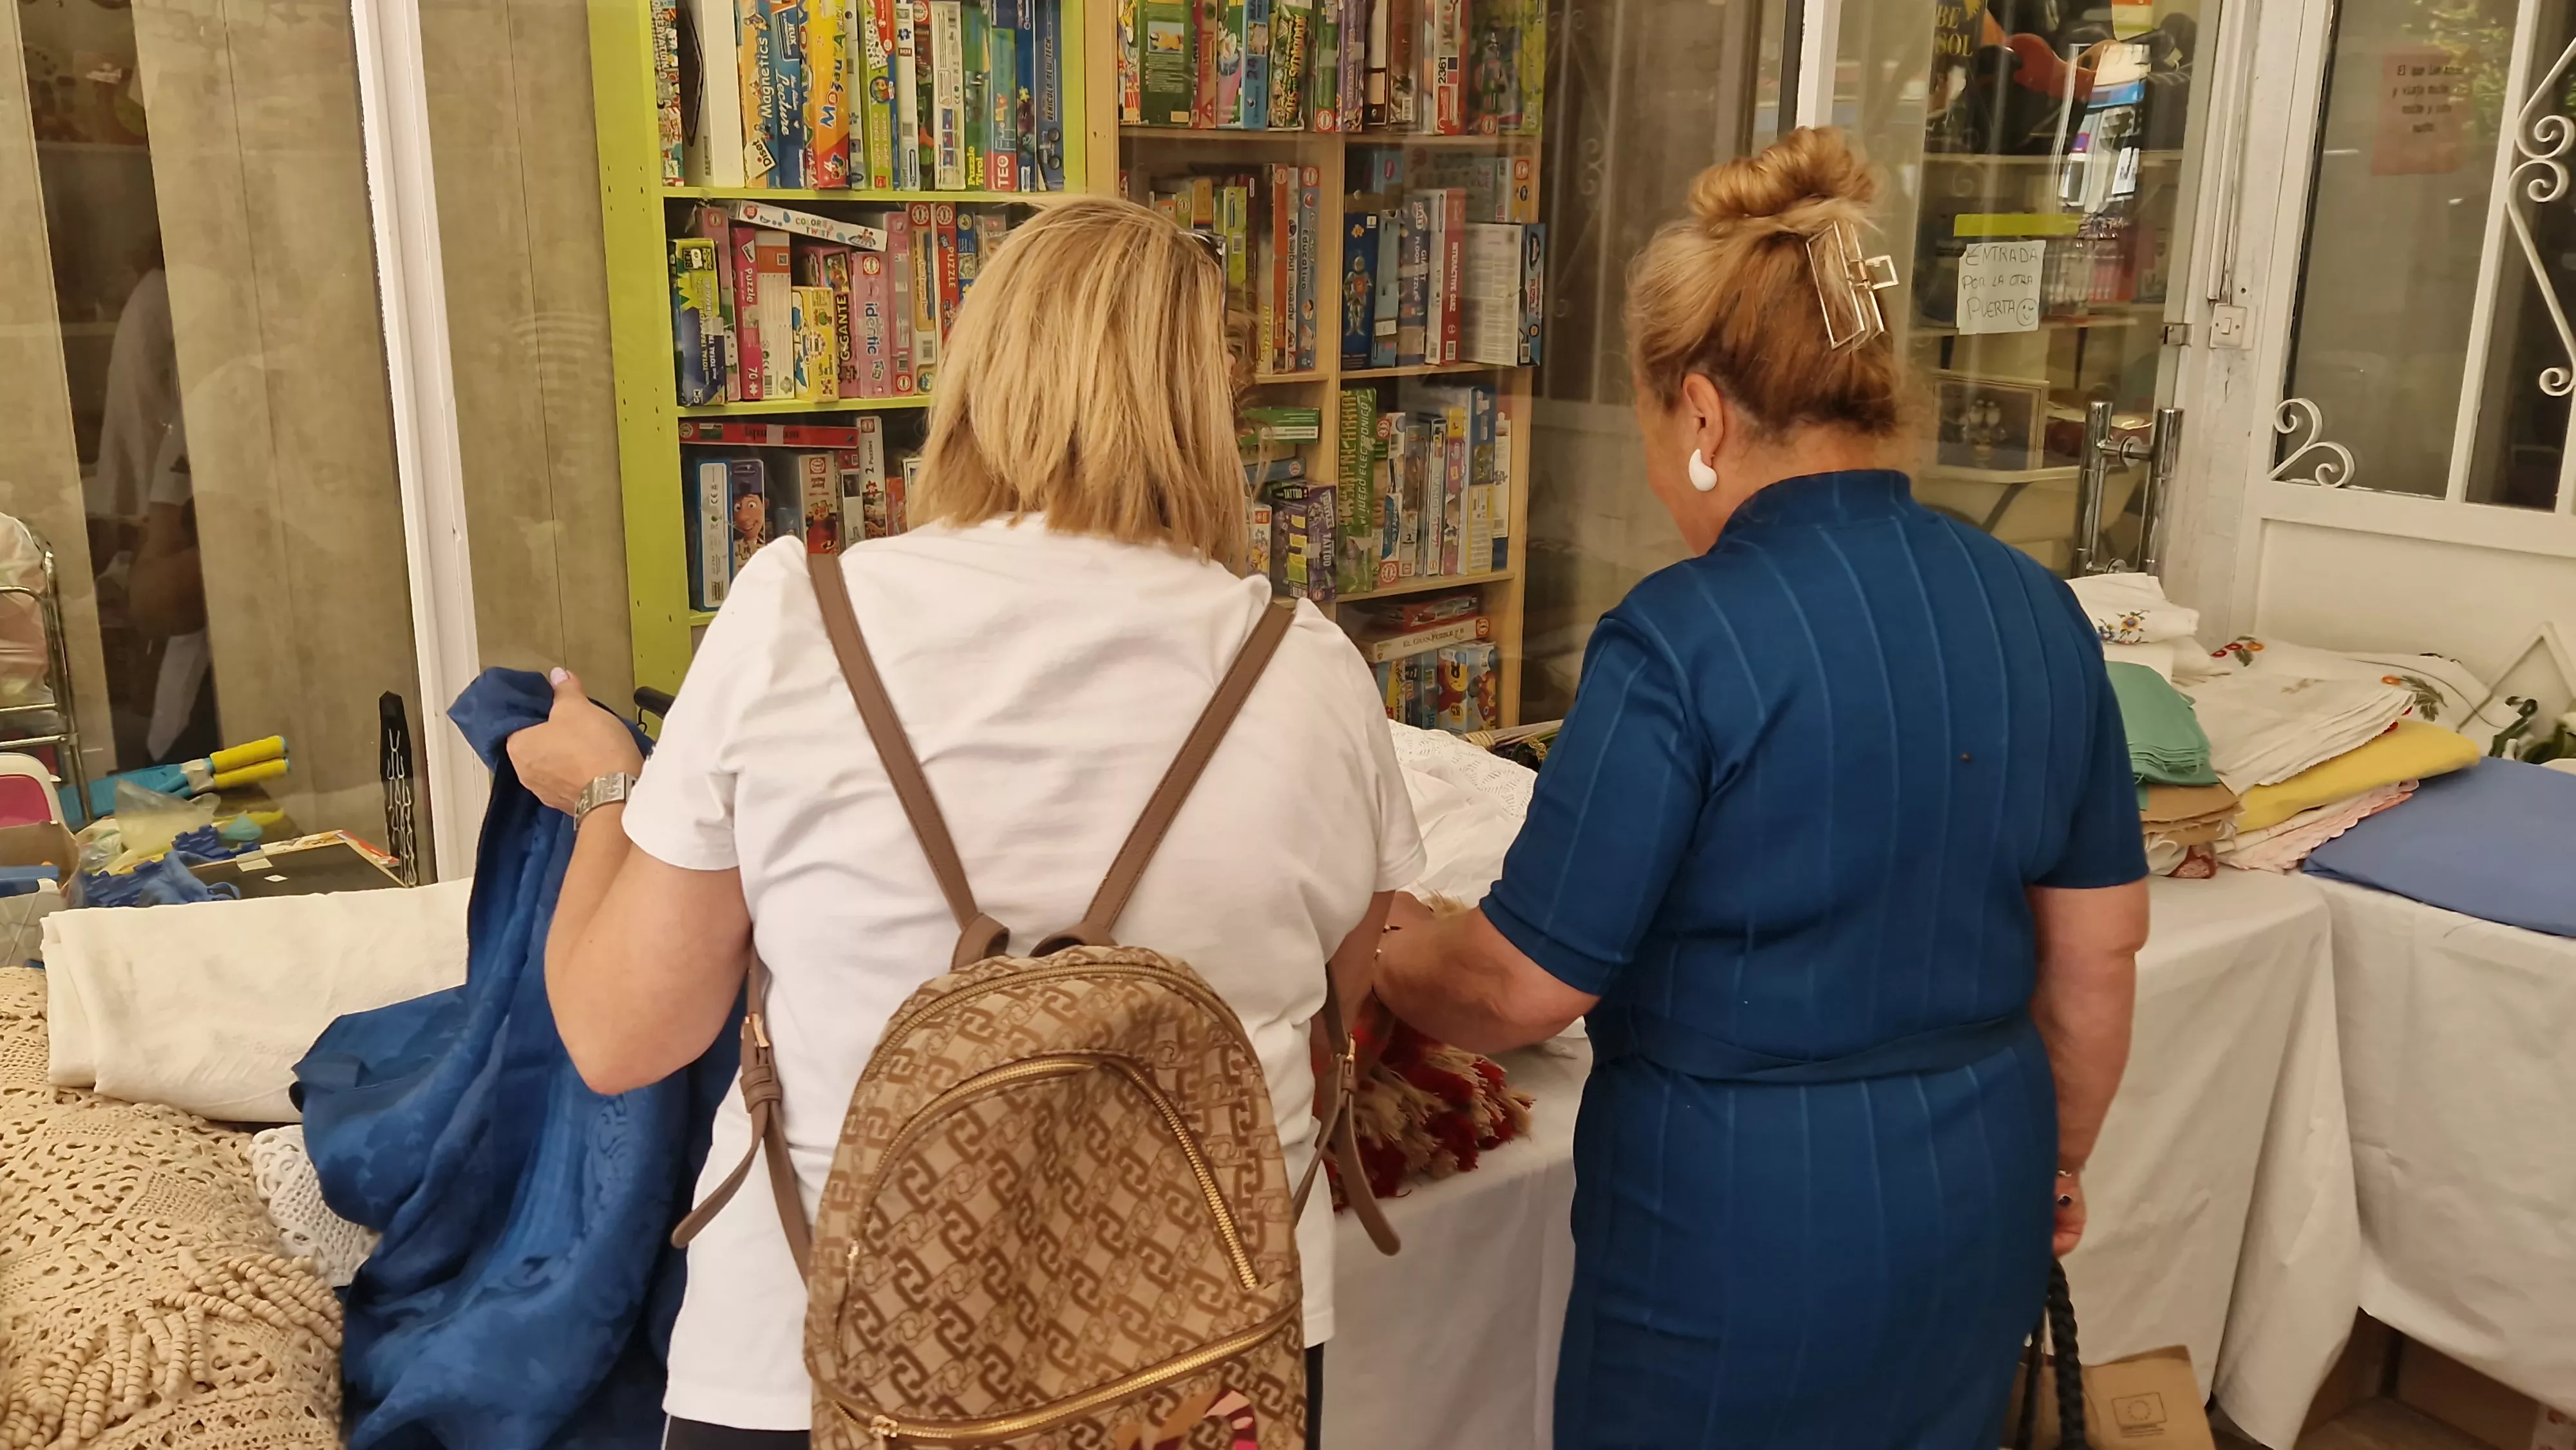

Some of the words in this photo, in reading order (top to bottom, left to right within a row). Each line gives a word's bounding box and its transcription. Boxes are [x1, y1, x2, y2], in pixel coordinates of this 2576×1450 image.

[757, 37, 774, 118] Magnetics
[1438, 57, 1446, 84] 2361
[774, 68, 793, 136] Lecture
[752, 138, 772, 167] Diset
[967, 145, 976, 186] Puzzle
[998, 155, 1010, 187] TEO
[947, 246, 956, 288] PUZZLE
[1419, 249, 1427, 282] GIAT
[1965, 244, 2038, 266] ENTRADA
[744, 267, 755, 303] Puzzle
[1961, 274, 1985, 290] POR
[1992, 276, 2004, 287] LA
[2009, 274, 2033, 287] OTRA
[1966, 297, 2016, 320] PUERTA
[864, 301, 880, 356] identic
[747, 366, 759, 381] 70
[1358, 478, 1367, 513] JUEGO
[1322, 532, 1332, 567] TATTOO
